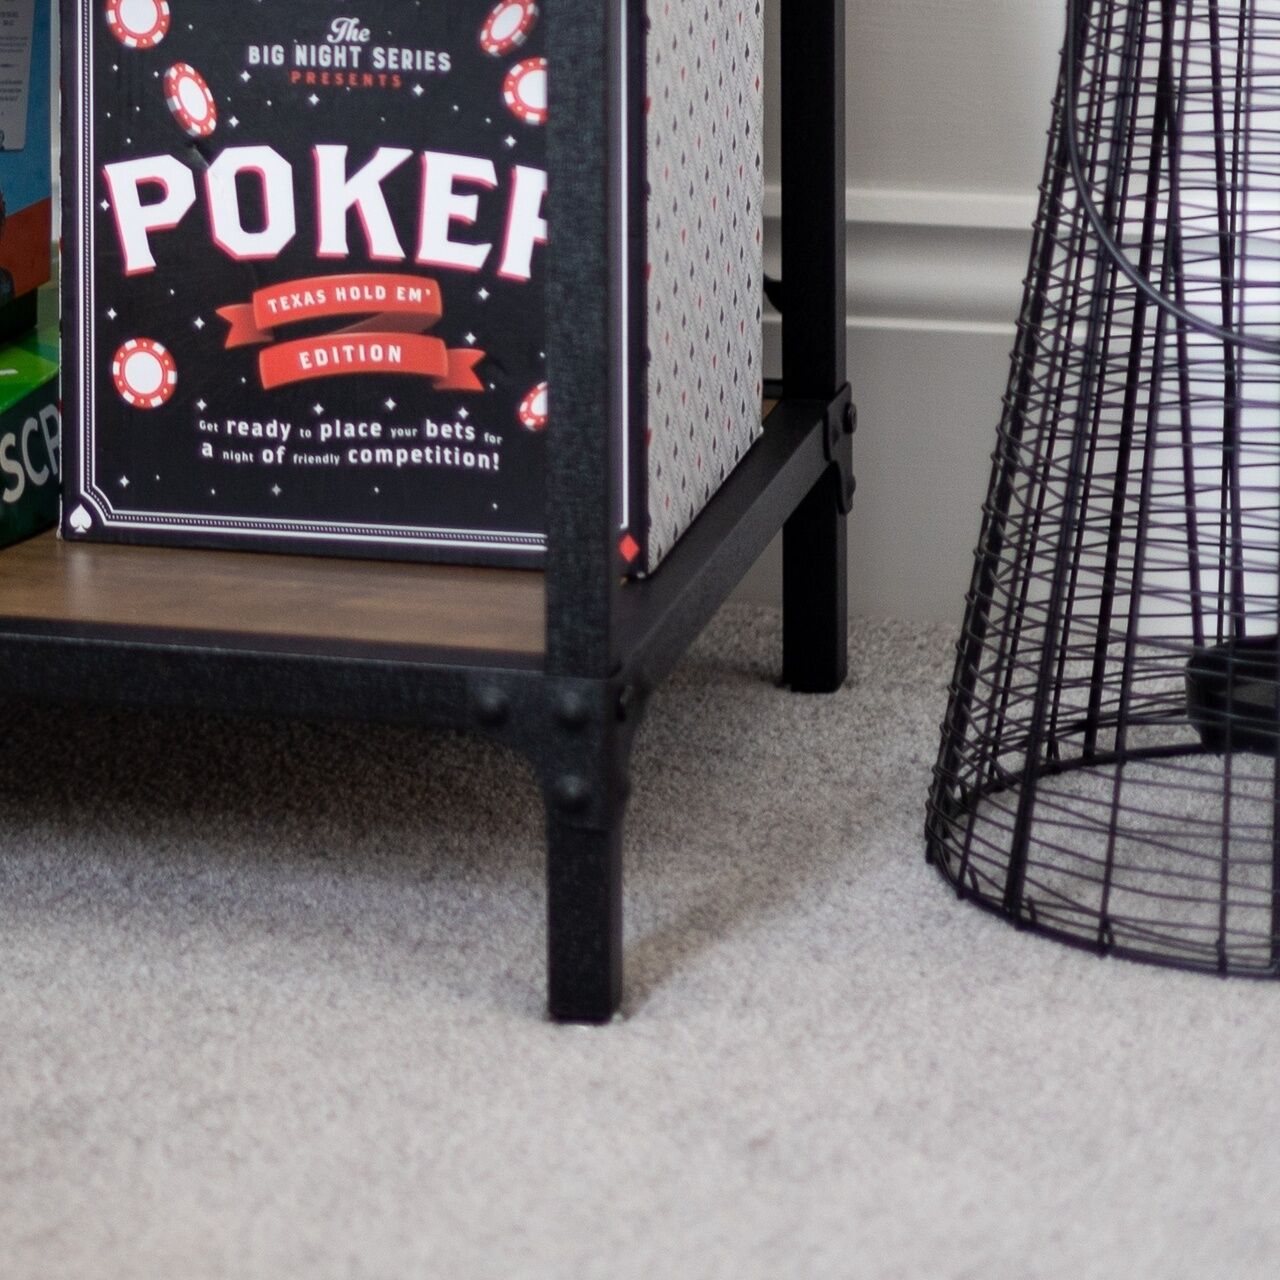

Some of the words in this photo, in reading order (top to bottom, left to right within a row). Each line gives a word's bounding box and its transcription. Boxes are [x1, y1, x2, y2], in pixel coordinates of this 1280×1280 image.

[326, 17, 371, 43] The
[248, 45, 285, 65] BIG
[295, 44, 362, 68] NIGHT
[372, 47, 451, 71] SERIES
[291, 71, 402, 88] PRESENTS
[268, 289, 326, 313] TEXAS
[335, 285, 387, 302] HOLD
[299, 344, 402, 370] EDITION
[199, 420, 218, 433] Get
[226, 420, 291, 441] ready
[300, 428, 312, 438] to
[320, 420, 382, 442] place
[390, 427, 418, 438] your
[425, 419, 475, 441] bets
[484, 432, 503, 445] for
[202, 442, 213, 457] a
[223, 450, 254, 463] night
[262, 446, 286, 463] of
[293, 453, 340, 465] friendly
[348, 446, 499, 471] competition!
